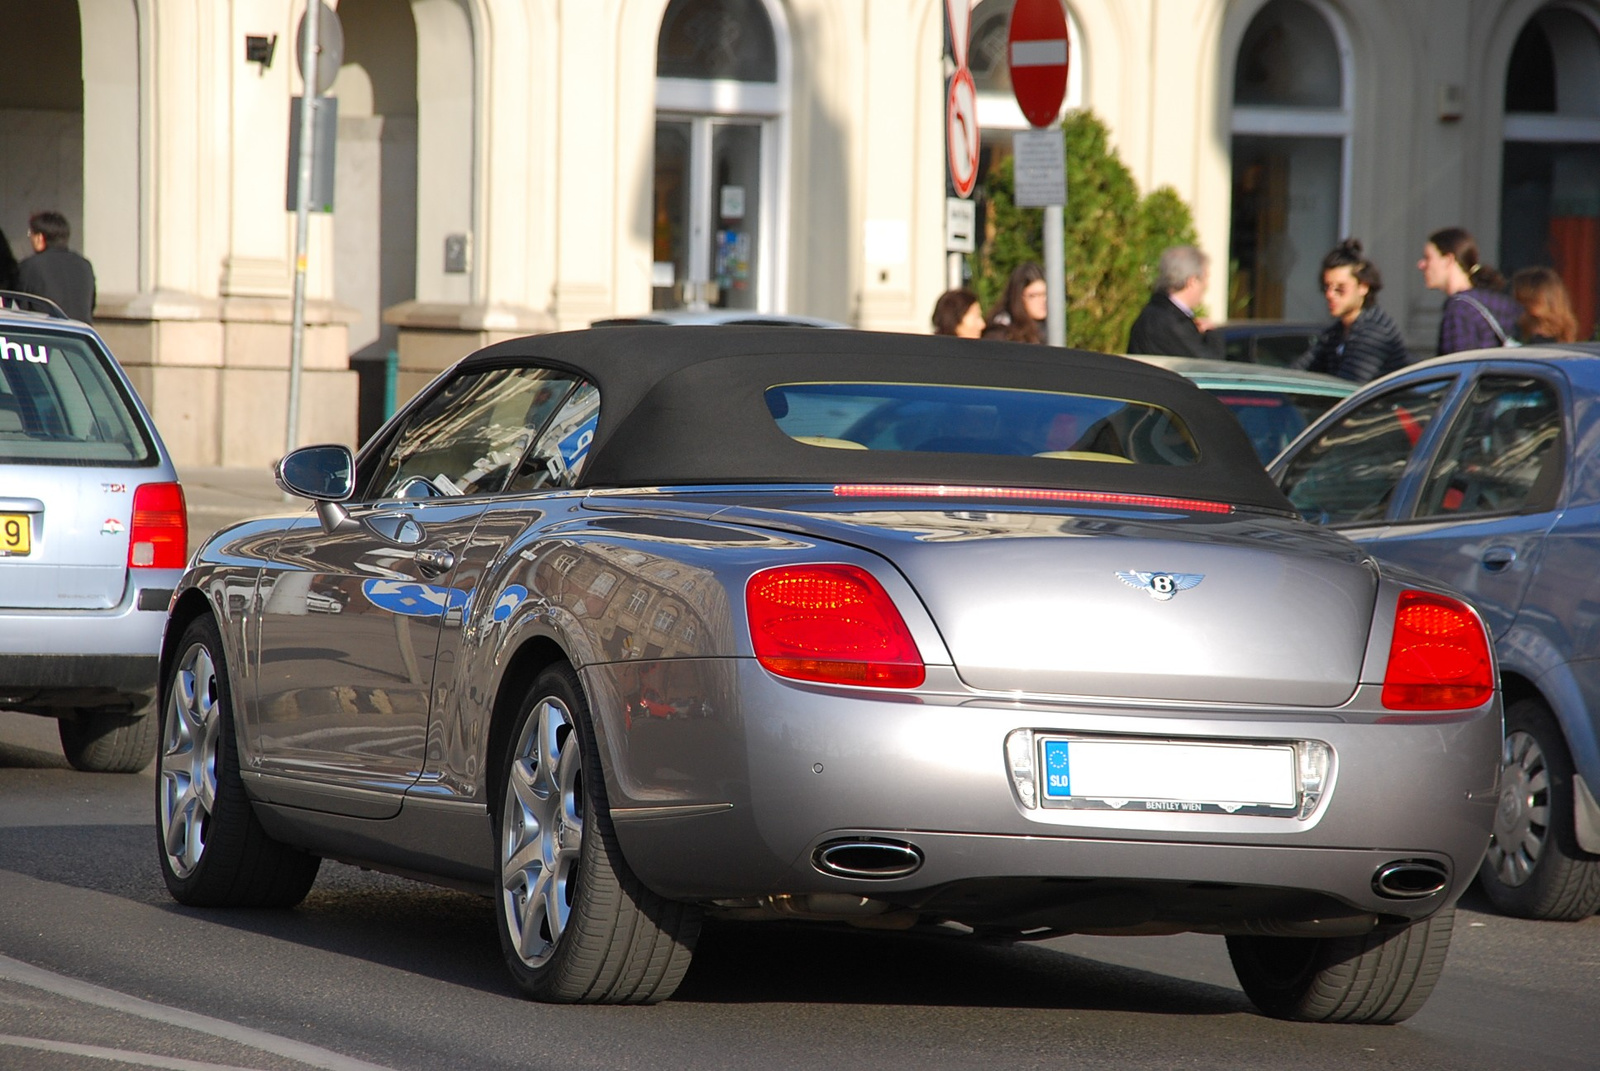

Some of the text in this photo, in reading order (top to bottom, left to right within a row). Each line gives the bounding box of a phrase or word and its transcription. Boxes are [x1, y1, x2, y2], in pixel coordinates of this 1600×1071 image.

[101, 483, 126, 493] TDI
[5, 520, 20, 546] 9
[1153, 575, 1172, 593] B
[1050, 775, 1069, 787] SLO
[1145, 801, 1202, 811] BENTLEY WIEN
